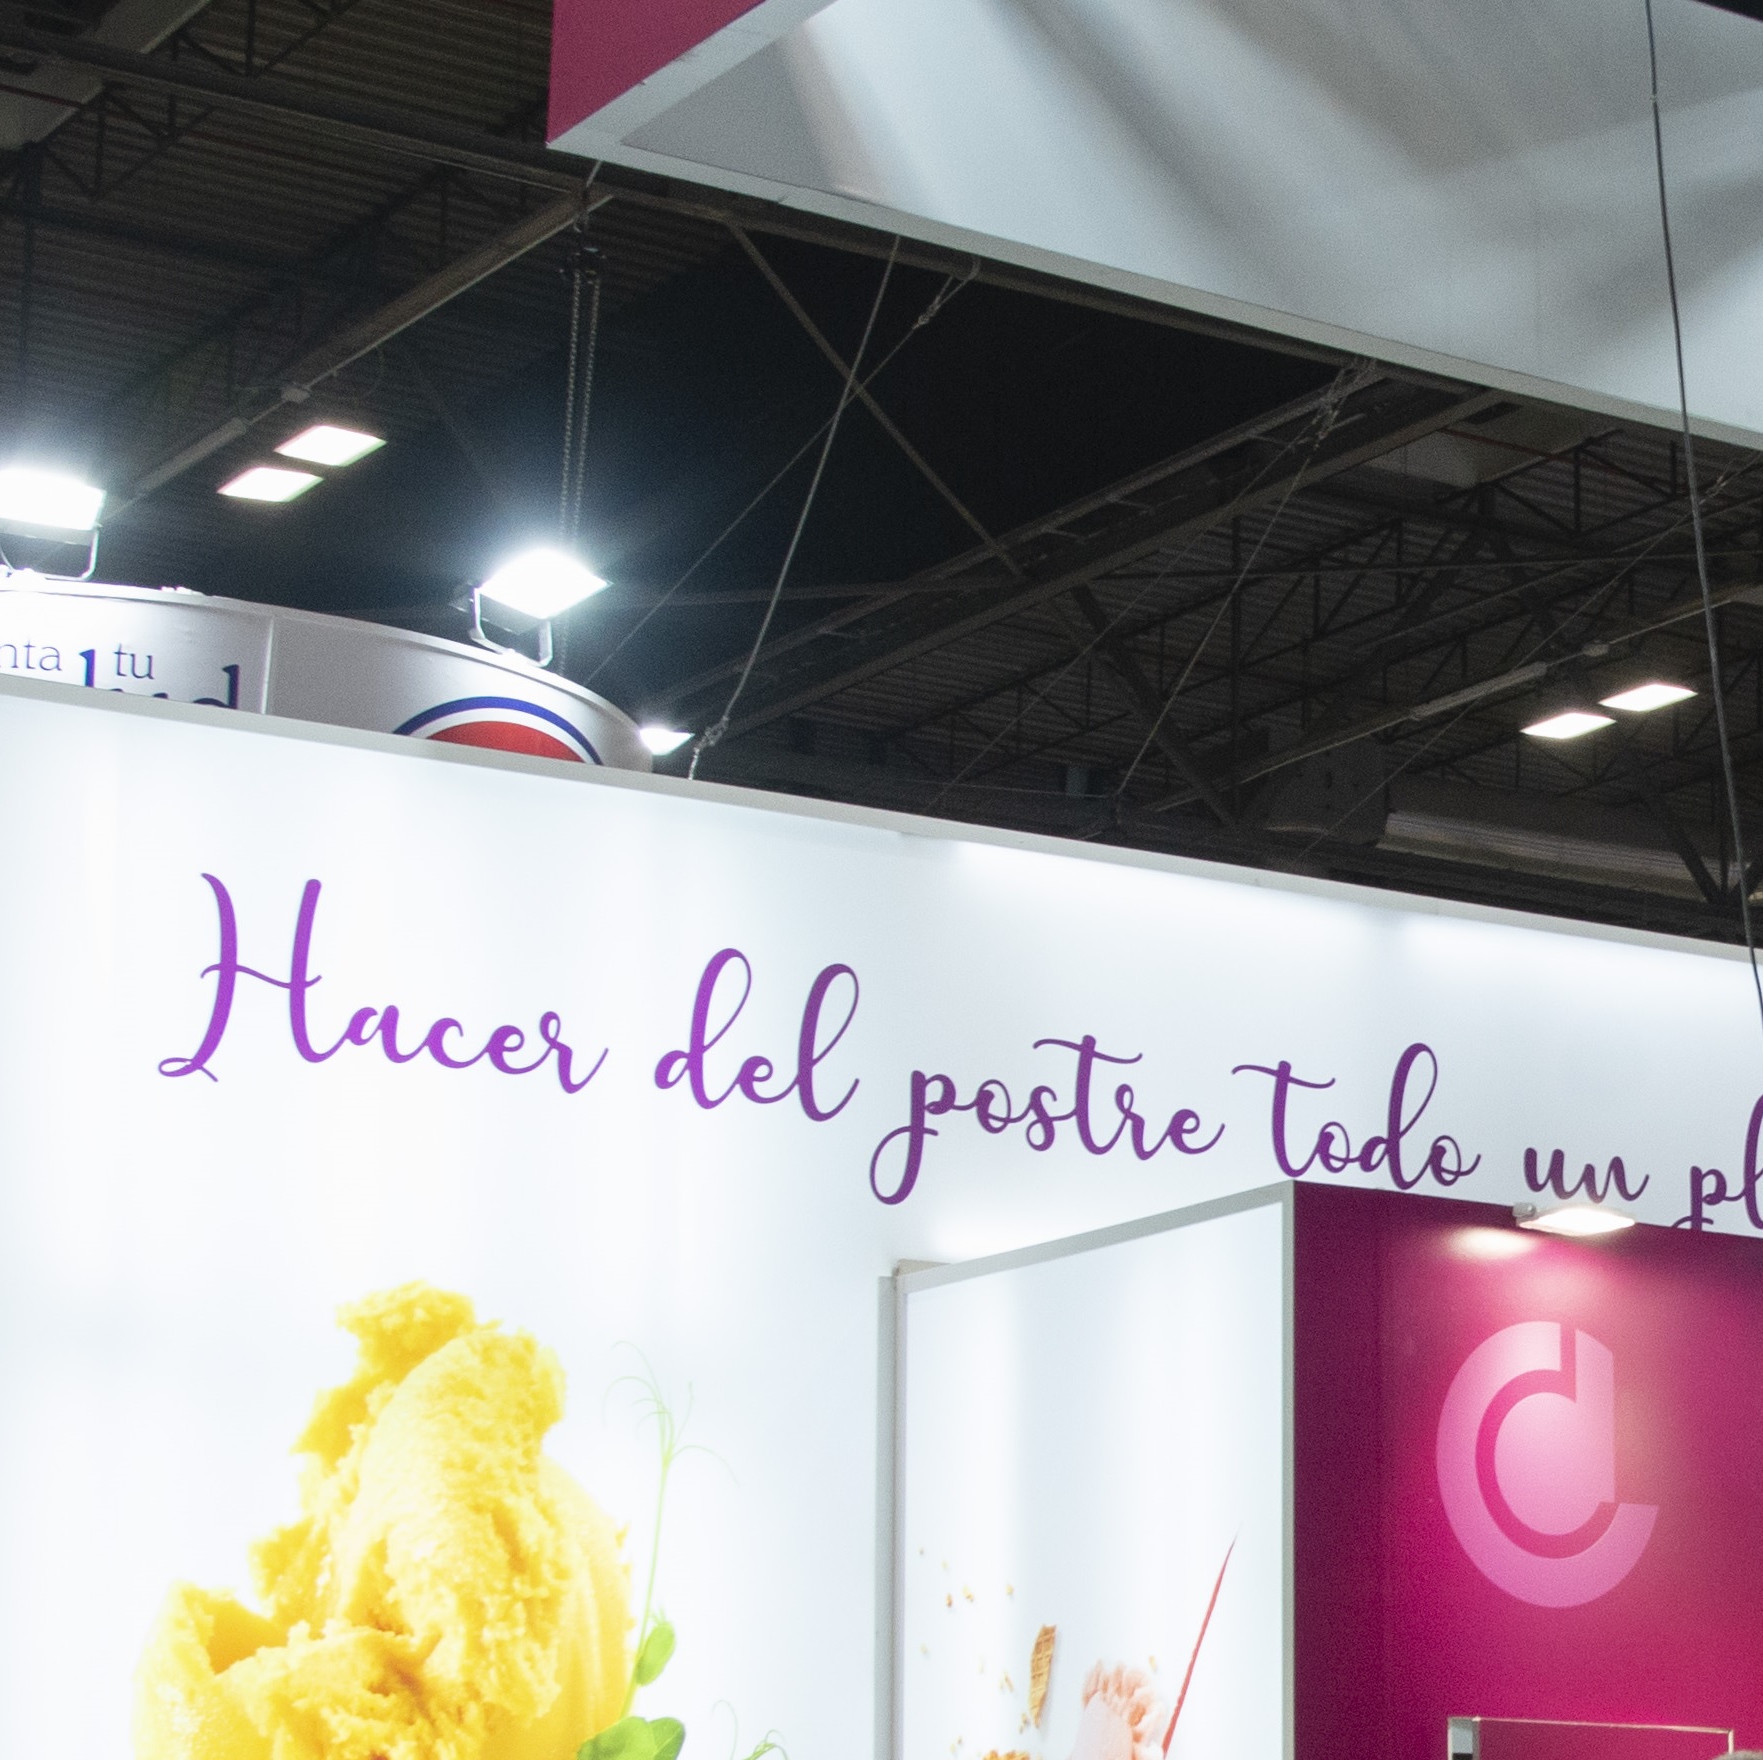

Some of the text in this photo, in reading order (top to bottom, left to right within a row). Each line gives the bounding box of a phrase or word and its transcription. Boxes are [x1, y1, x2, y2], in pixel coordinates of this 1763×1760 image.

[114, 642, 155, 682] tu
[159, 871, 609, 1094] Hacer
[654, 947, 861, 1123] del
[870, 1030, 1223, 1206] postre
[1231, 1043, 1481, 1190] todo
[1524, 1143, 1650, 1206] un
